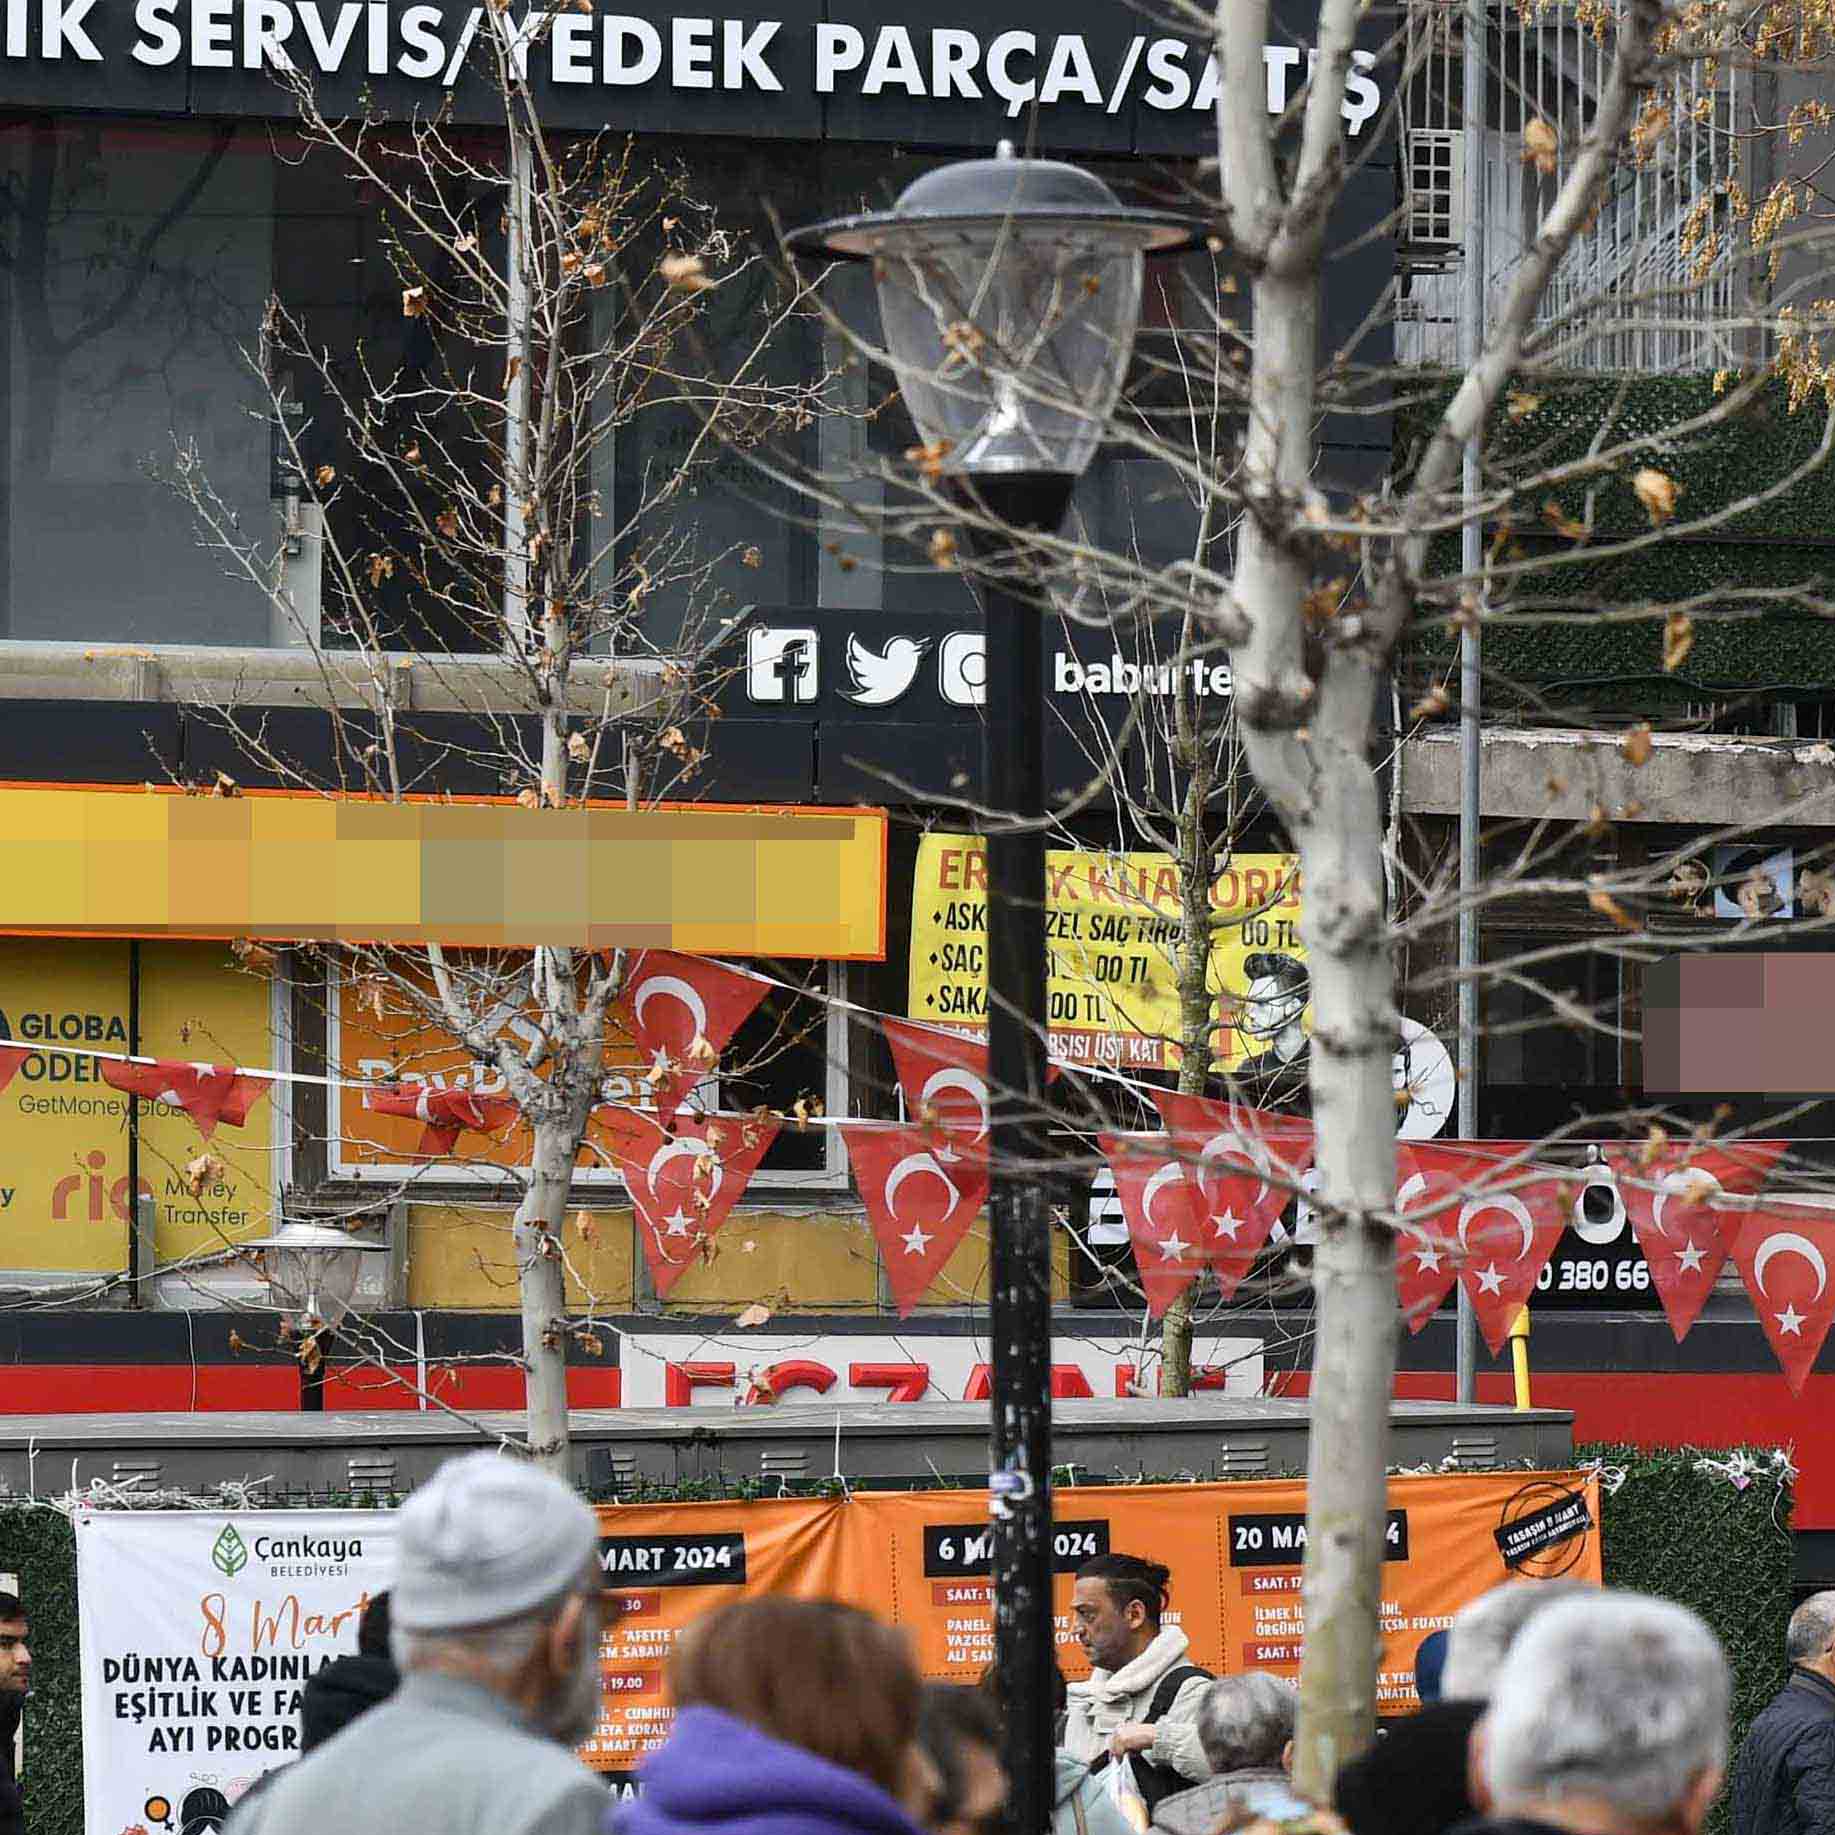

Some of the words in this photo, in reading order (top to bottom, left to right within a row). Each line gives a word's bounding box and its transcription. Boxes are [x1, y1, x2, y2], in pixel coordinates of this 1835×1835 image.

[1089, 914, 1131, 948] SAÇ
[941, 943, 983, 978] SAÇ
[1129, 1039, 1164, 1063] KAT
[164, 1204, 248, 1225] Transfer
[1557, 1262, 1607, 1291] 380
[1614, 1261, 1650, 1291] 66
[254, 1534, 363, 1561] Çankaya
[939, 1537, 956, 1561] 6
[1235, 1526, 1263, 1549] 20
[270, 1563, 348, 1578] BELEDİYESİ
[673, 1545, 732, 1570] 2024
[201, 1592, 226, 1659] 8
[253, 1590, 371, 1652] Mart
[103, 1653, 200, 1685] DÜNYA
[114, 1685, 218, 1724] EŞİTLİK
[228, 1691, 261, 1716] VE
[149, 1726, 194, 1752] AYI
